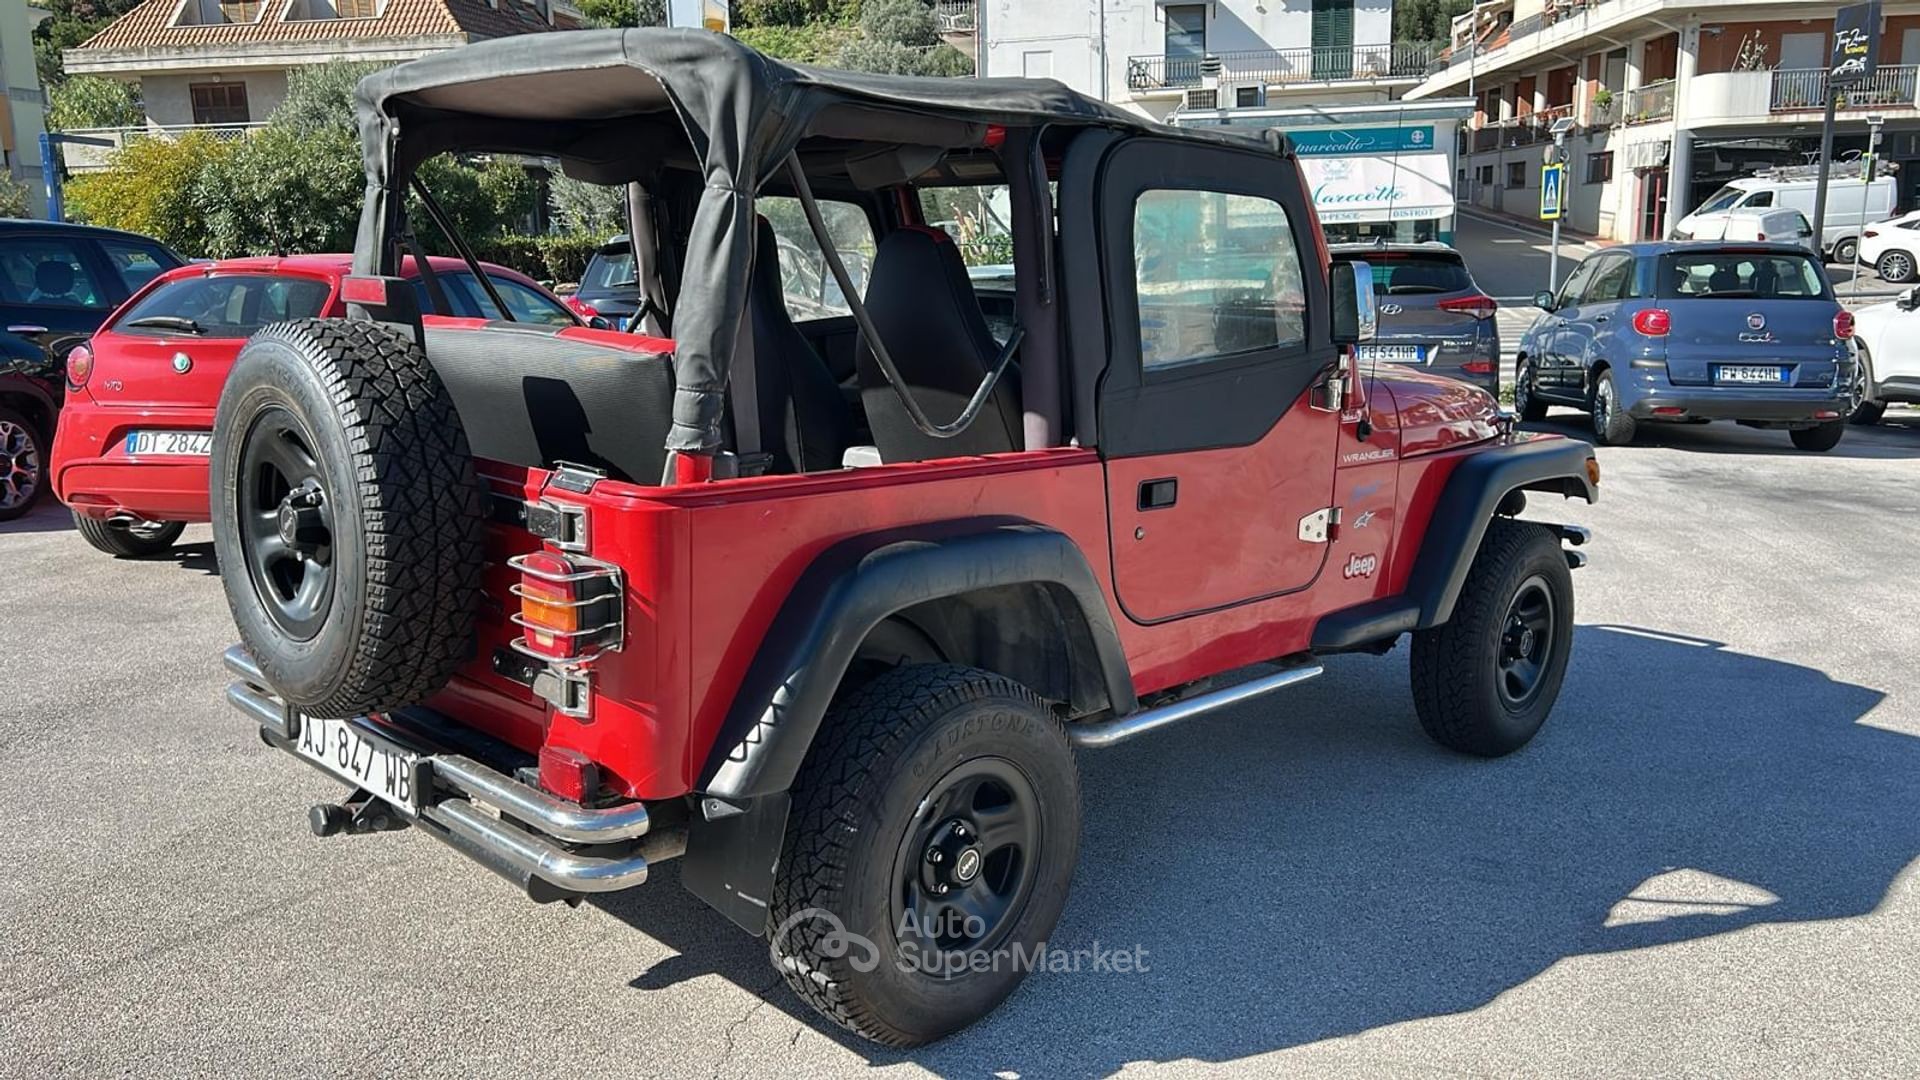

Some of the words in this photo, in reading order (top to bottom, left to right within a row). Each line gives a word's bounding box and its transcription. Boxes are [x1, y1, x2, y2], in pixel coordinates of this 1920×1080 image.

[138, 433, 160, 453] DT
[1342, 448, 1394, 463] WRANGLER
[1344, 553, 1376, 578] Jeep
[303, 715, 326, 757] AJ
[338, 727, 375, 782] 847
[385, 749, 411, 802] WB
